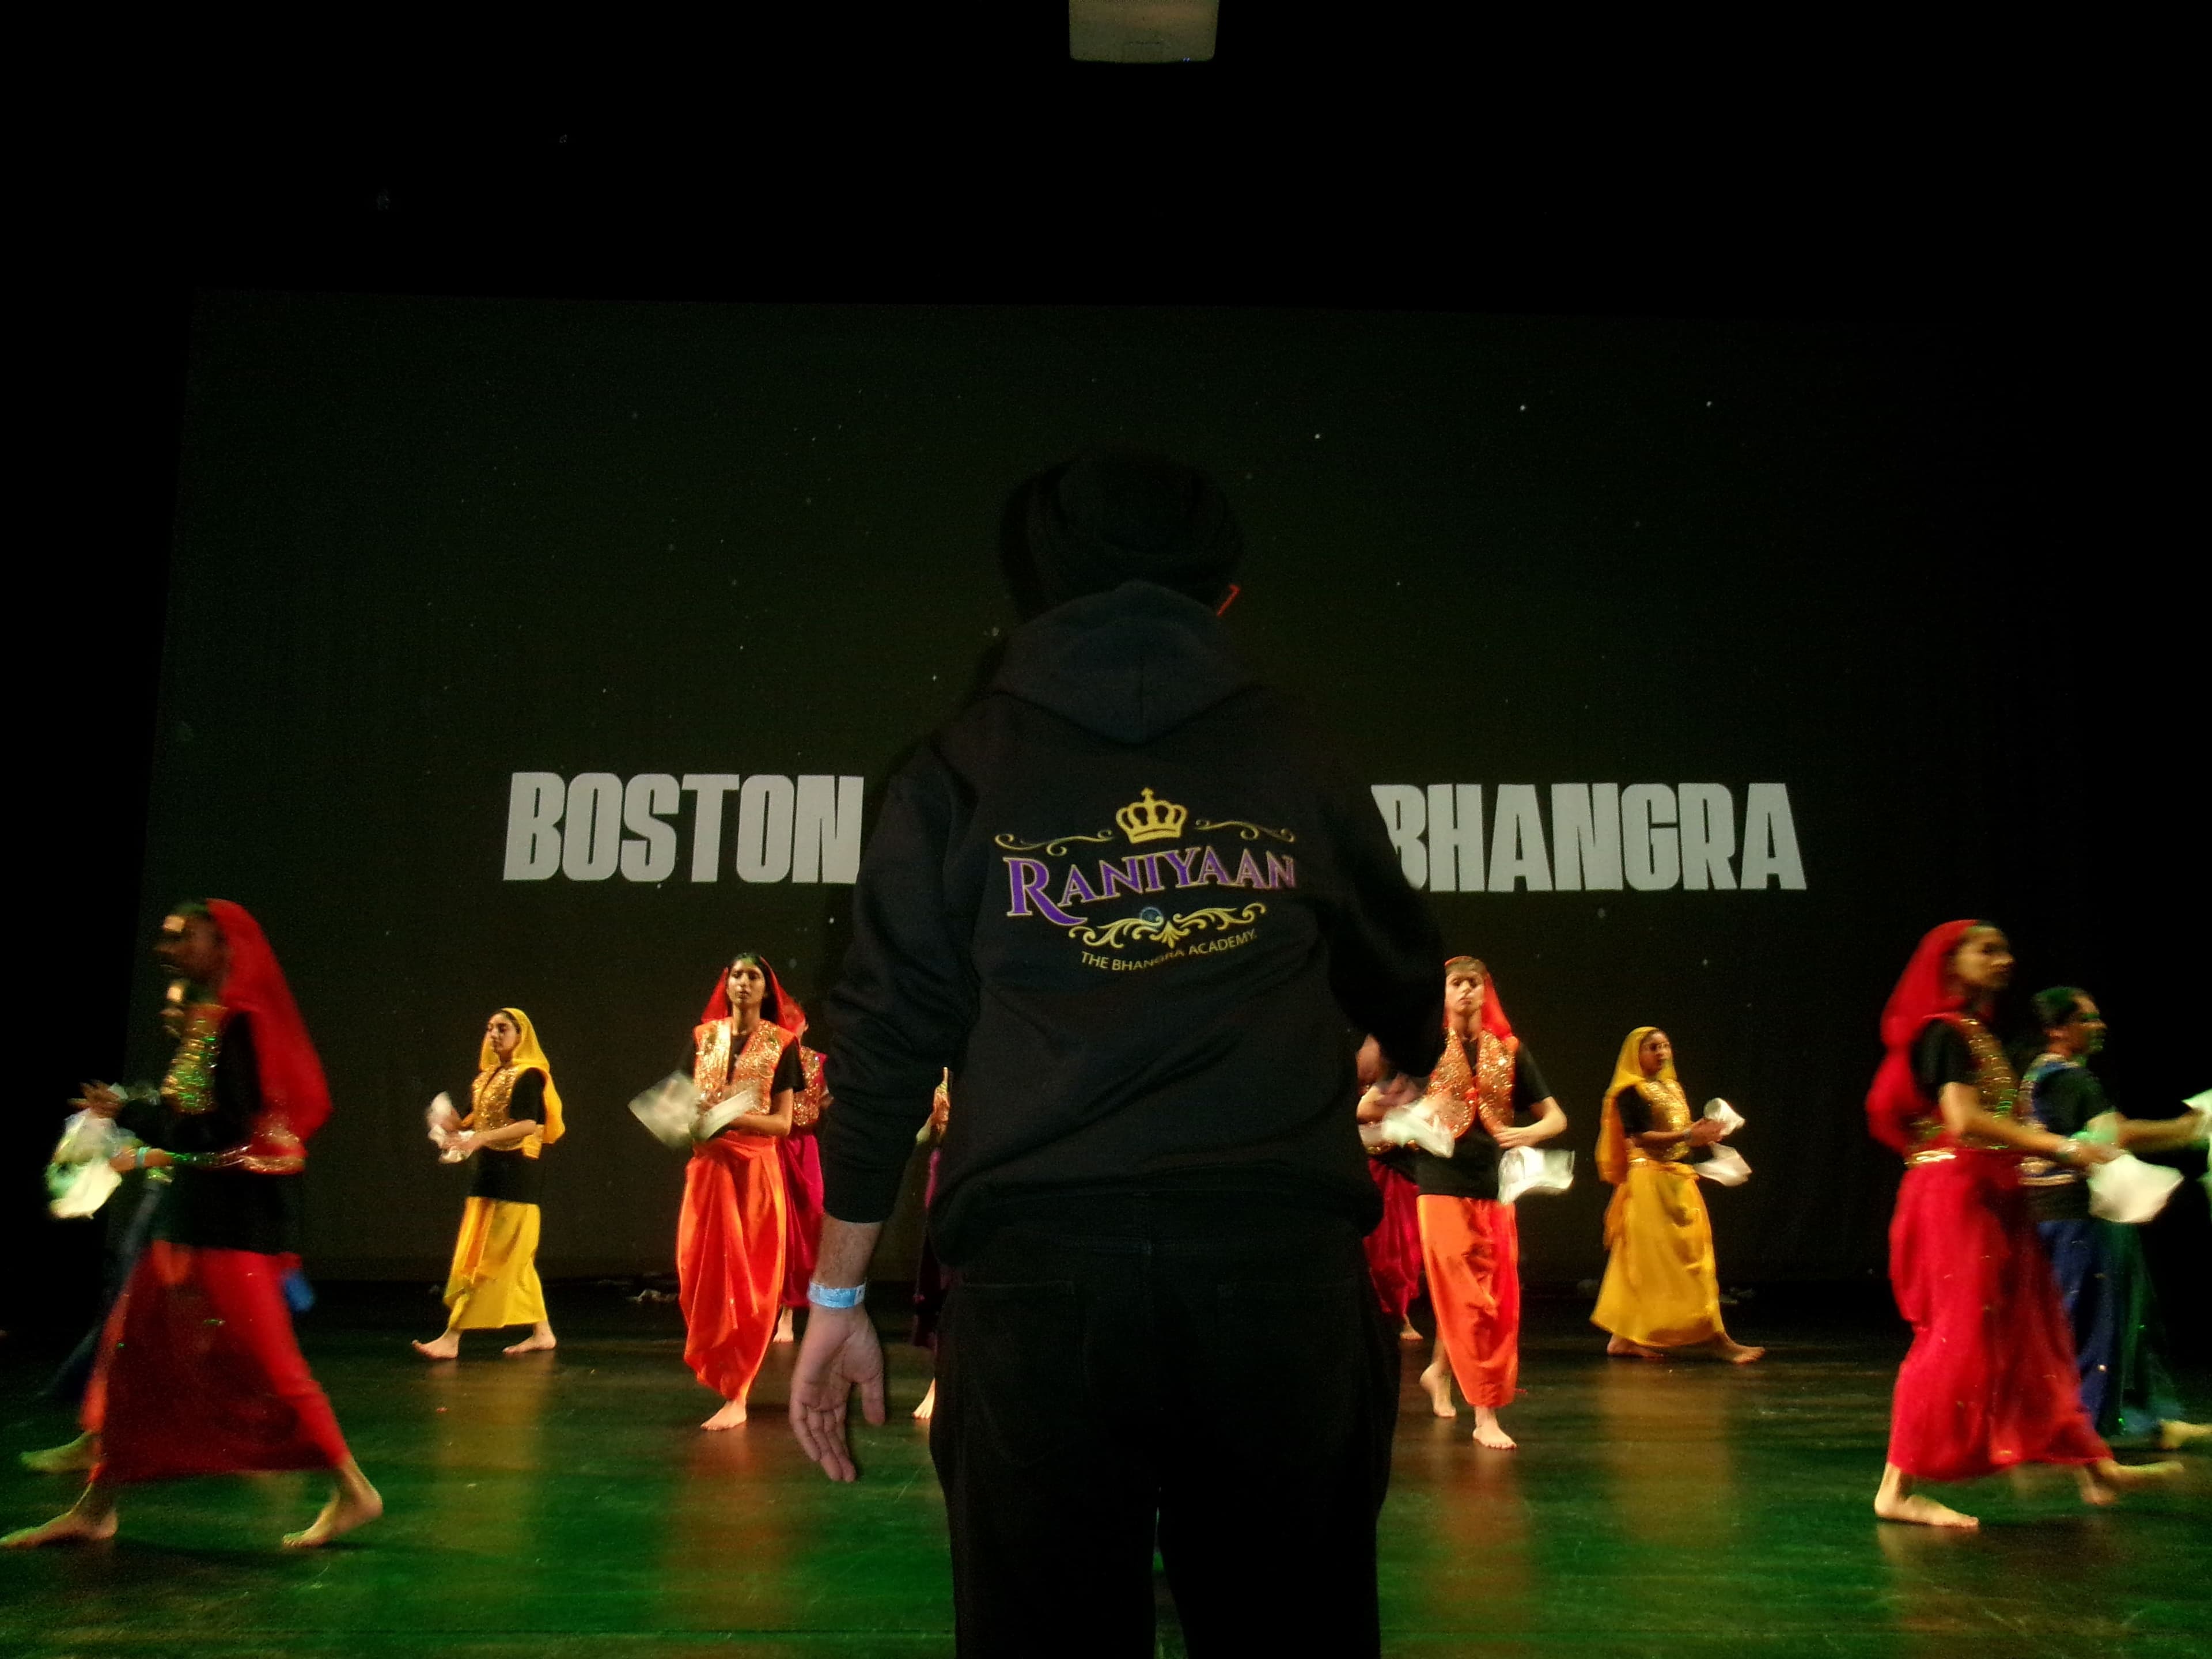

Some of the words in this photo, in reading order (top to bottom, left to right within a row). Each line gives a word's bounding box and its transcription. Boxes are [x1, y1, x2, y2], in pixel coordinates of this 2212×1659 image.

[503, 772, 864, 884] BOSTON
[1370, 782, 1807, 892] BHANGRA
[1002, 846, 1296, 926] RANIYAAN
[1081, 950, 1109, 970] THE
